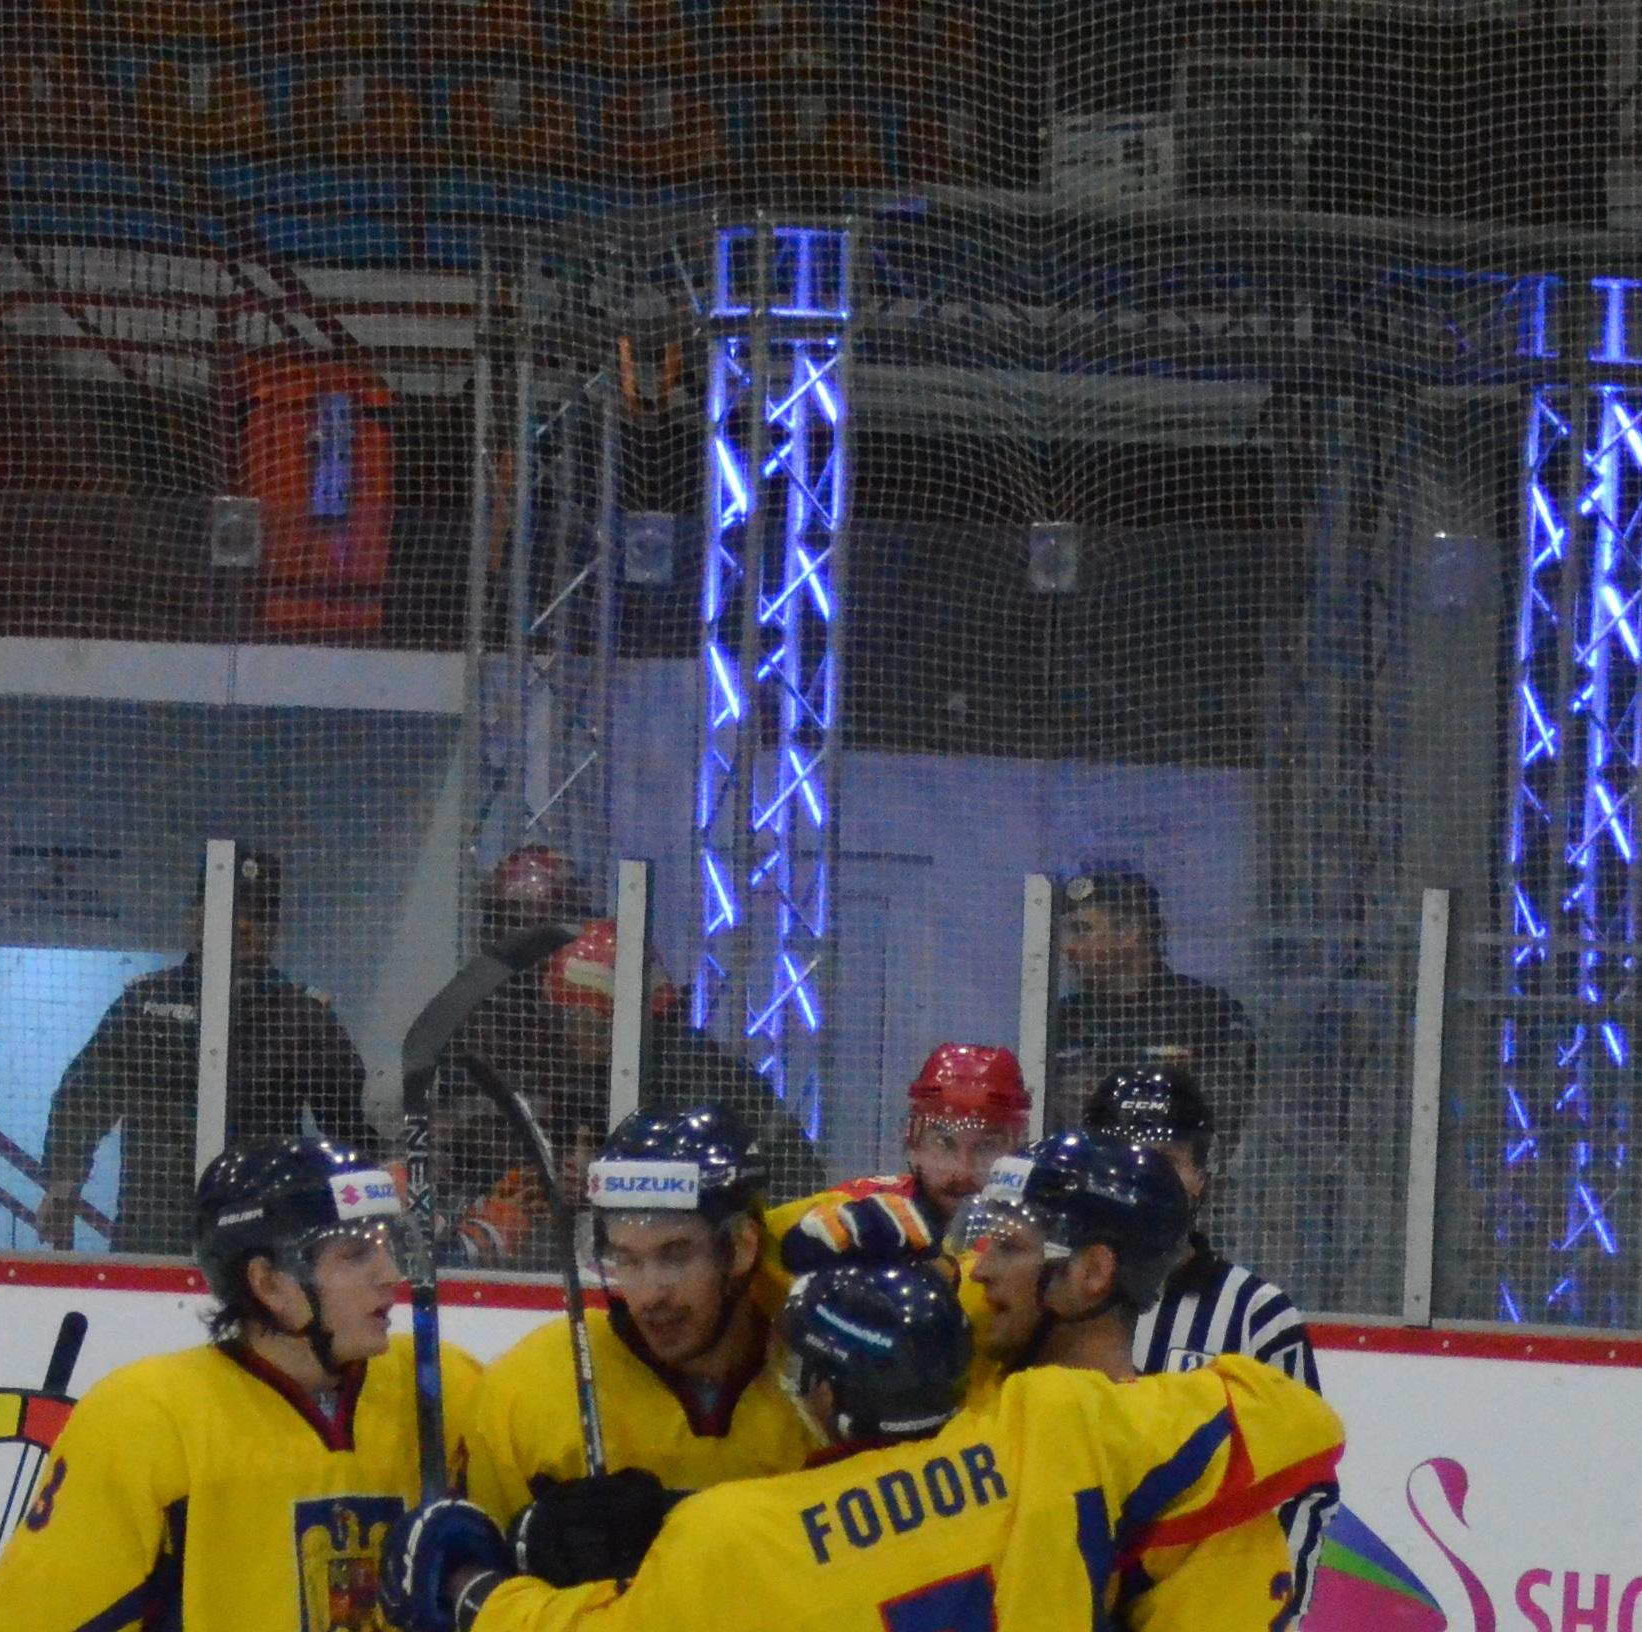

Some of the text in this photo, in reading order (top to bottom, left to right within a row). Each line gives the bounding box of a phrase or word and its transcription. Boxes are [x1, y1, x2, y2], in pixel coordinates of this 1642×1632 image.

[1120, 1100, 1168, 1113] CCM
[605, 1176, 695, 1193] SUZUKI
[801, 1443, 1008, 1565] FODOR
